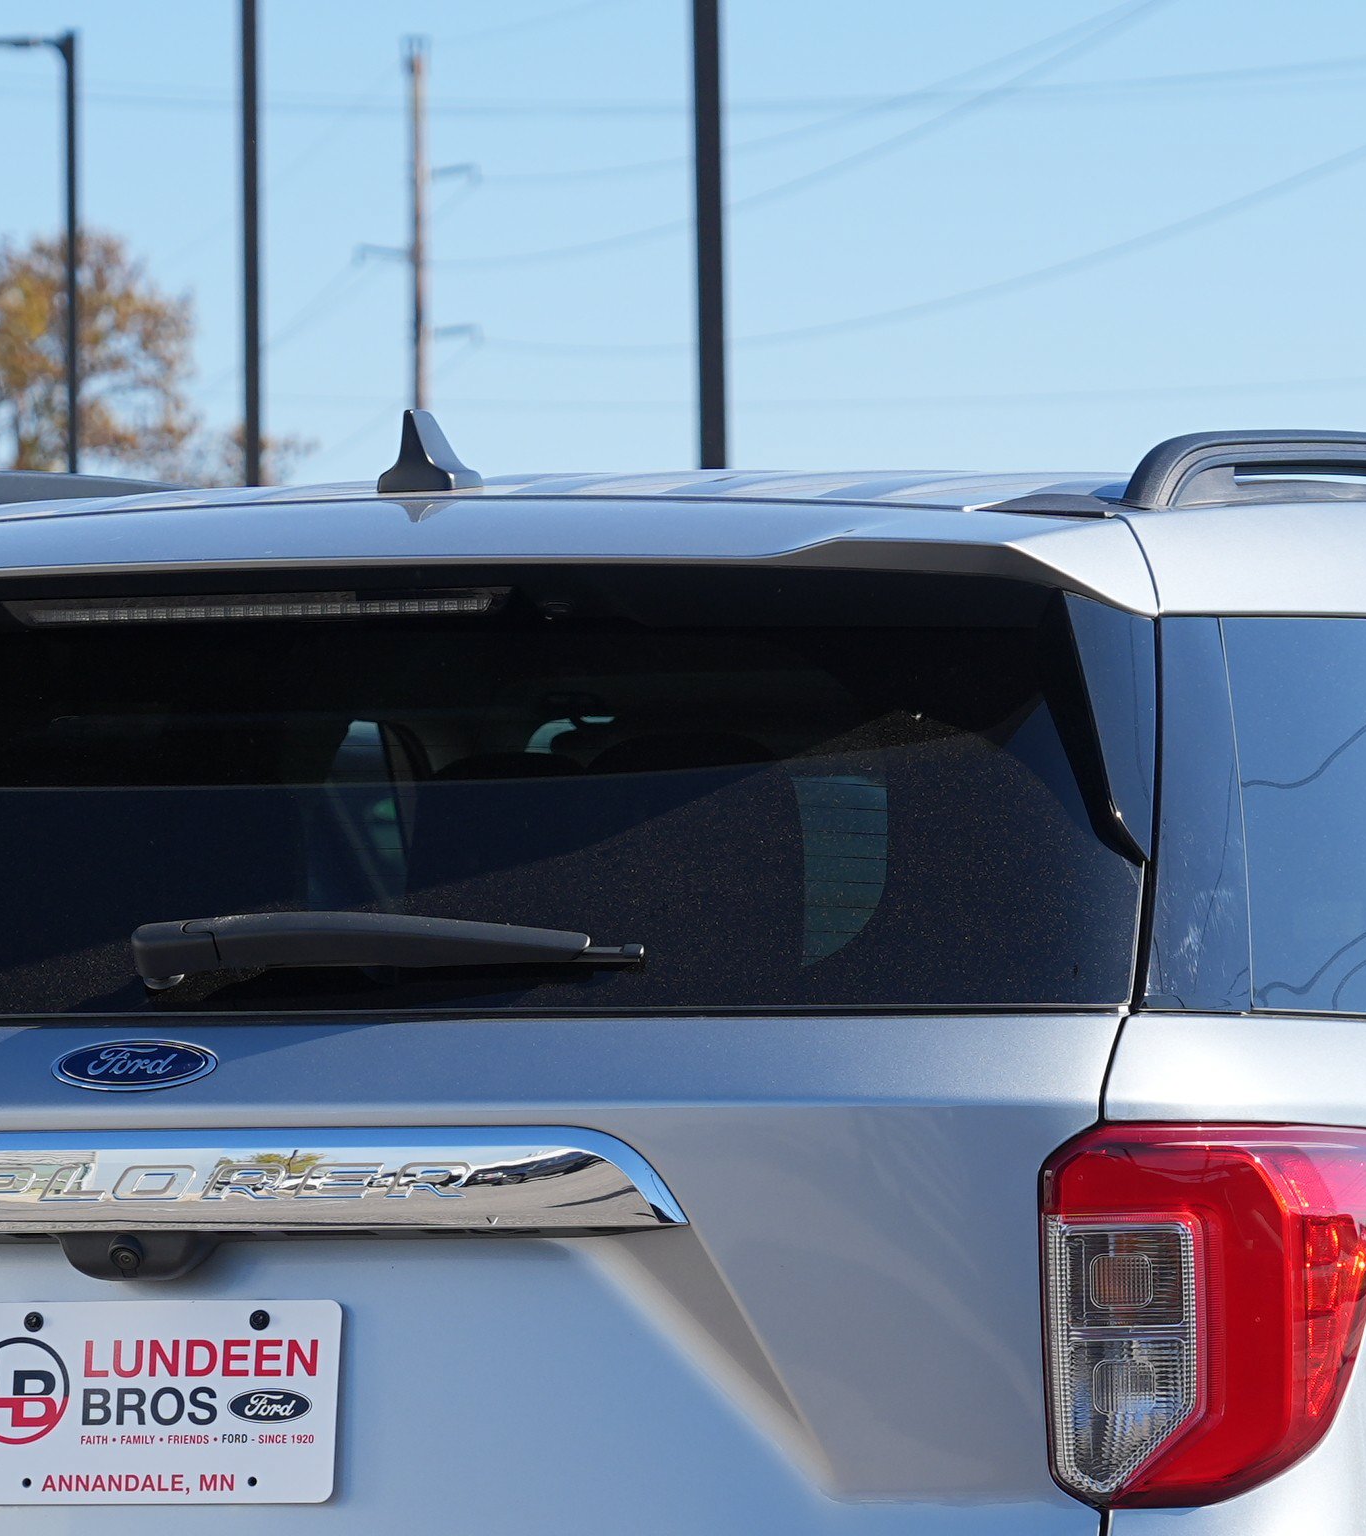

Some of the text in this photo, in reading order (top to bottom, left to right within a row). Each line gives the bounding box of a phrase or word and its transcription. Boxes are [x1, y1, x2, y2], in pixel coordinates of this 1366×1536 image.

[83, 1339, 319, 1379] LUNDEEN
[81, 1386, 218, 1426] BROS
[80, 1433, 315, 1445] FAITH FAMILY FRIENDS FORD SINCE 1920
[41, 1474, 235, 1495] ANNANDALE, MN
